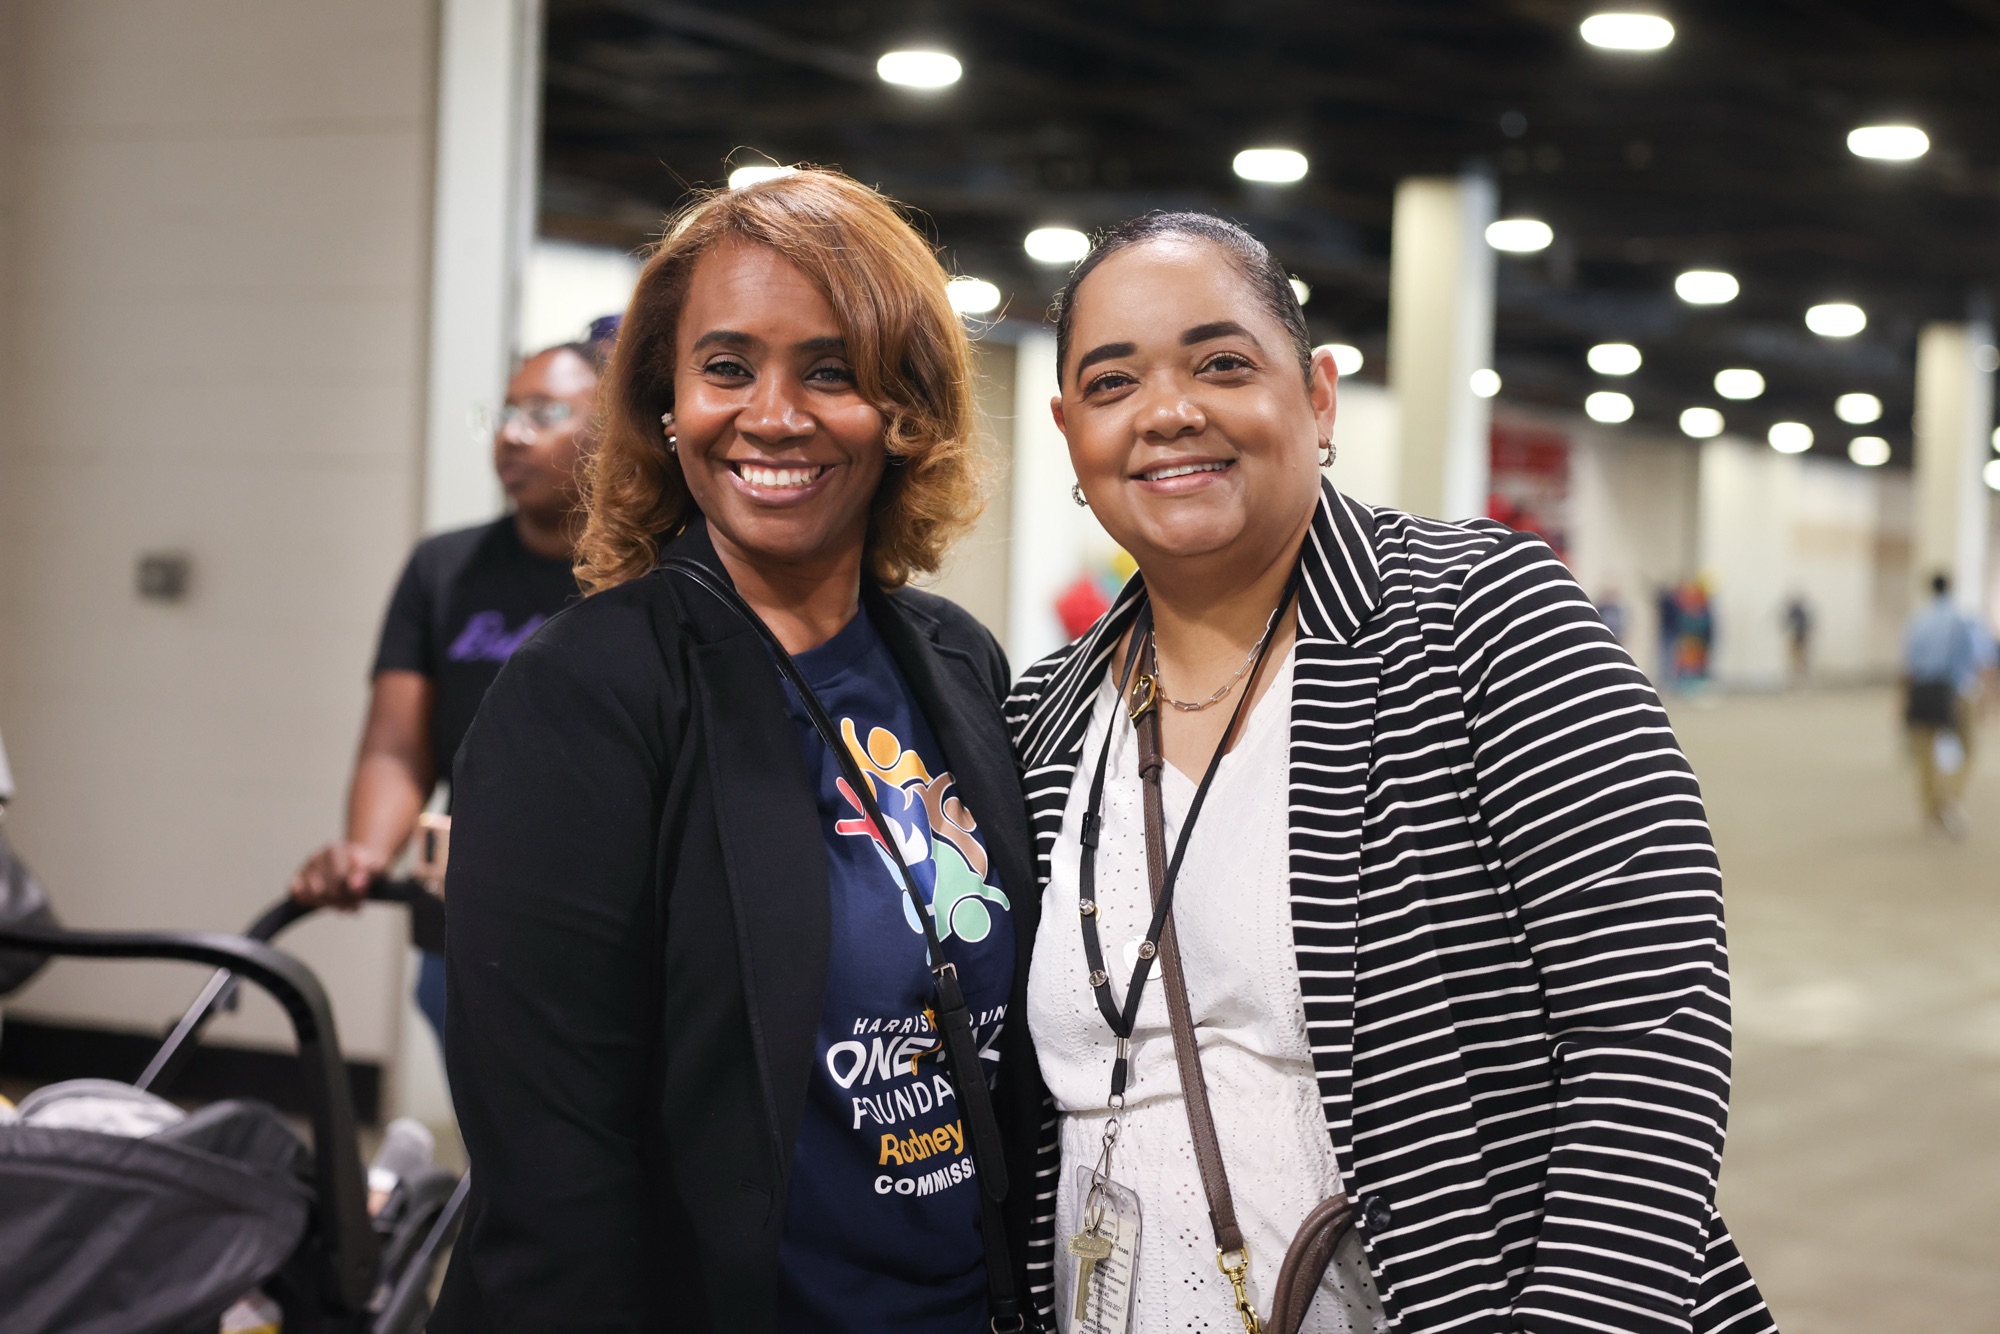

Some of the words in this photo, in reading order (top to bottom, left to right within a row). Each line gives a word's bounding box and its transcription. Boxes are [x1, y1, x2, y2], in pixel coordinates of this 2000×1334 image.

[853, 1014, 930, 1035] HARRIS
[826, 1036, 936, 1089] ONE
[852, 1074, 956, 1130] FOUNDA
[879, 1119, 965, 1166] Rodney
[874, 1155, 976, 1197] COMMISSI
